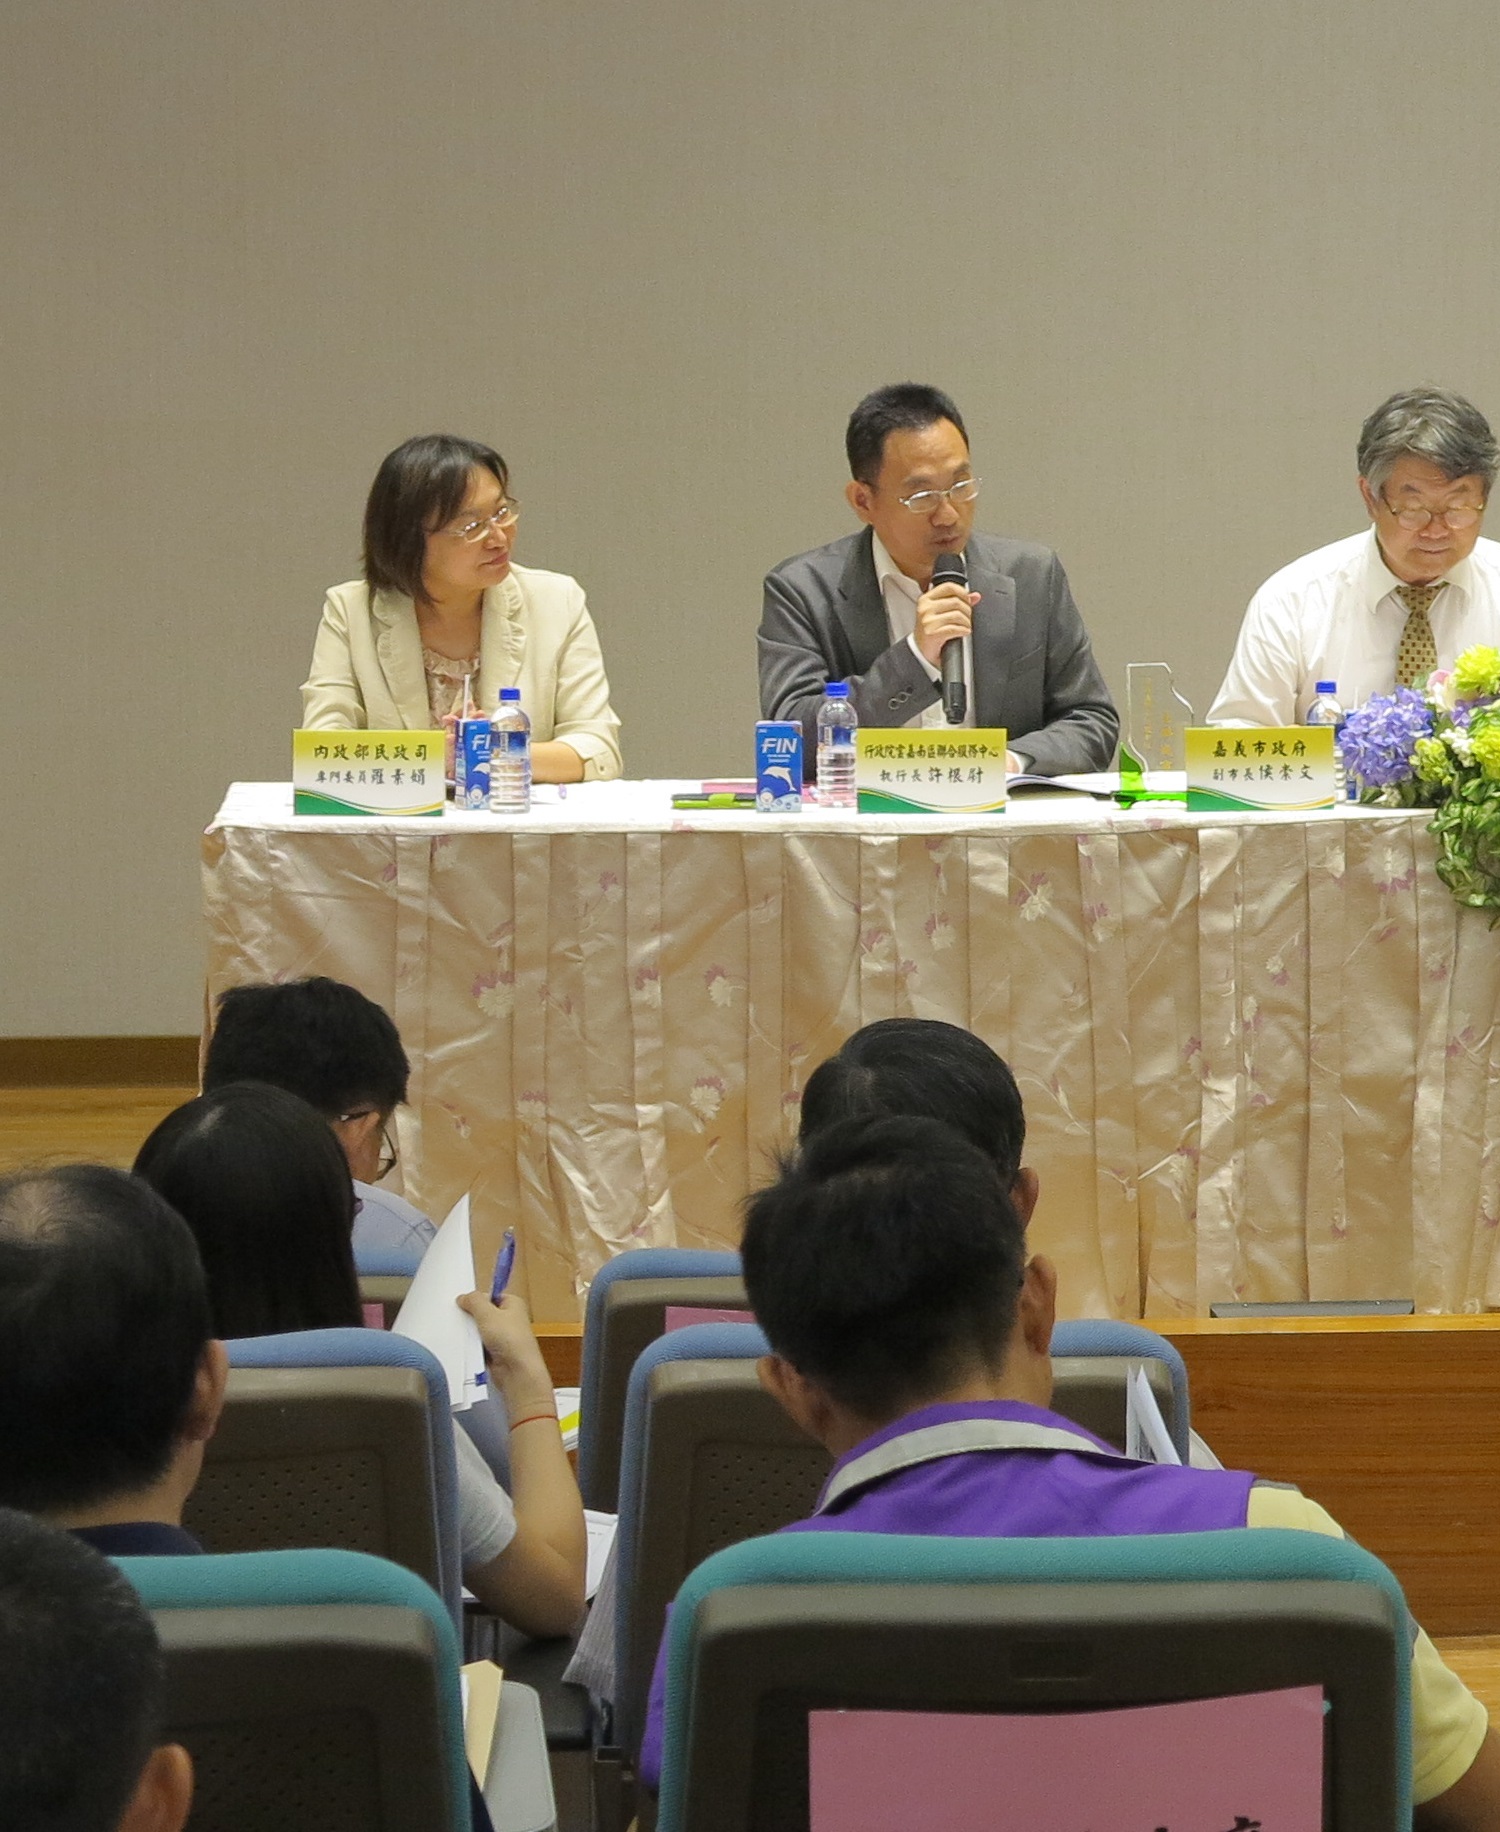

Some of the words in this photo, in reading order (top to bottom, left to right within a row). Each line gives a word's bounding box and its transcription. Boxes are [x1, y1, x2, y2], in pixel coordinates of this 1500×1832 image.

[472, 734, 491, 751] FI
[762, 737, 798, 754] FIN
[1212, 739, 1307, 757] 嘉義市政府
[314, 744, 428, 761] 內政部民政司
